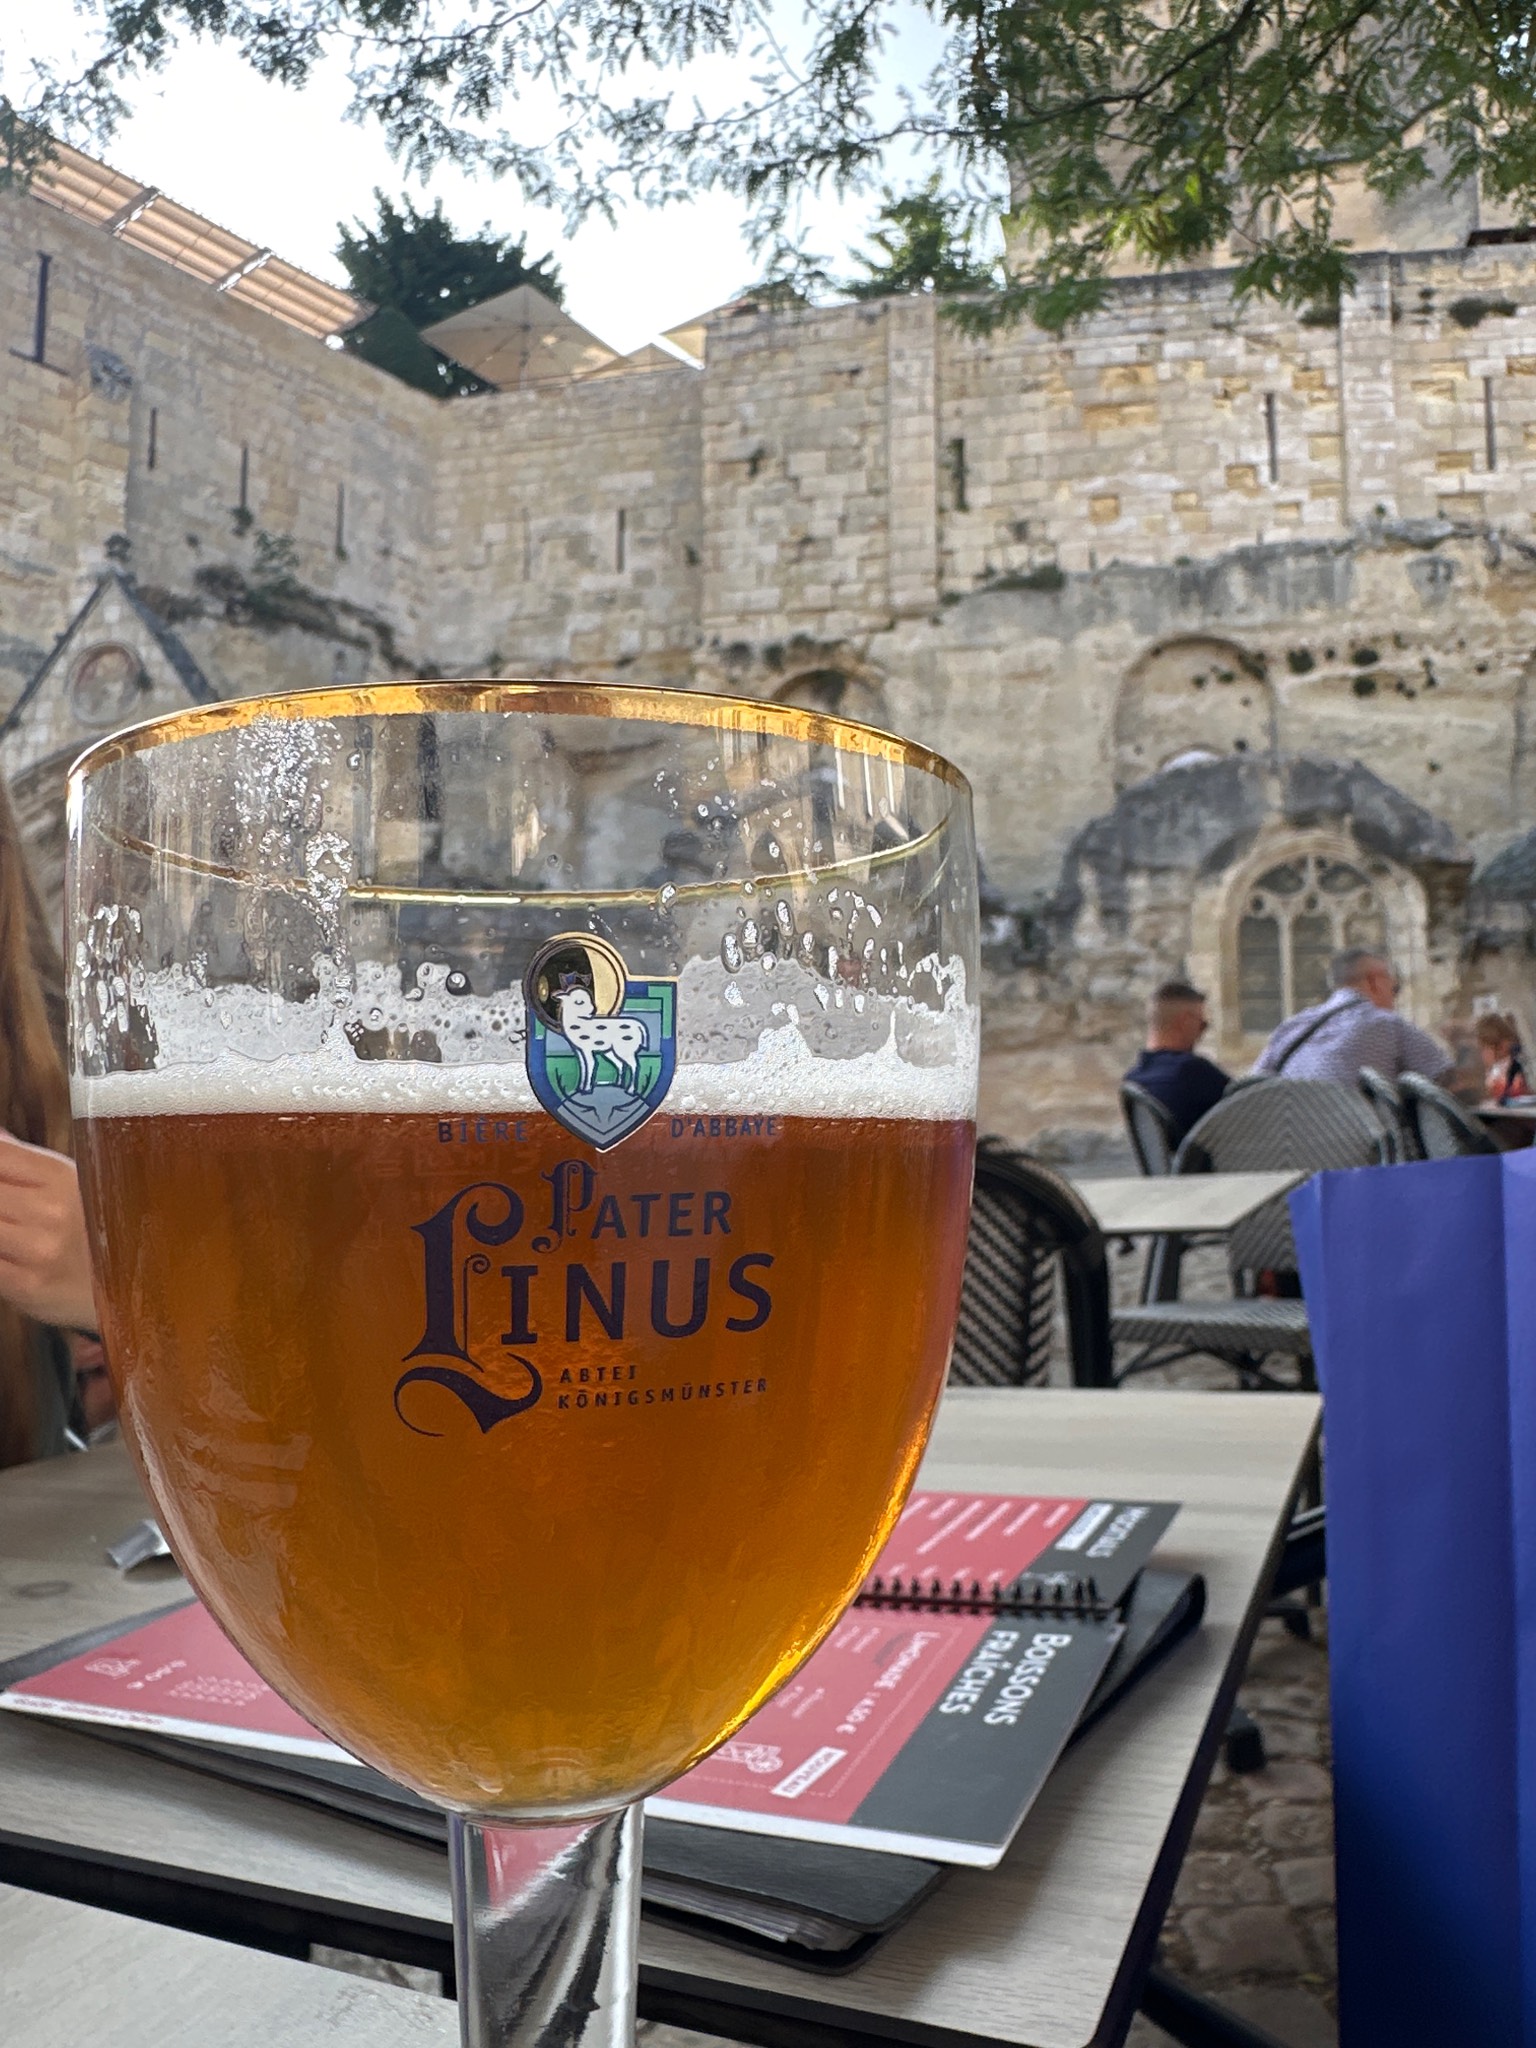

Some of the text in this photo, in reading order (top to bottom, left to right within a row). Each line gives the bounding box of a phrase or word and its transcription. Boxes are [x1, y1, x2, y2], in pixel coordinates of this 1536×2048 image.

[438, 1115, 779, 1144] BIÈRE D'ABBAYE
[532, 1159, 732, 1254] PATER
[394, 1182, 775, 1437] LINUS
[557, 1377, 768, 1409] KÖNIGSMÜNSTER
[559, 1365, 637, 1384] ABTEI
[983, 1633, 1072, 1726] BOISSONS
